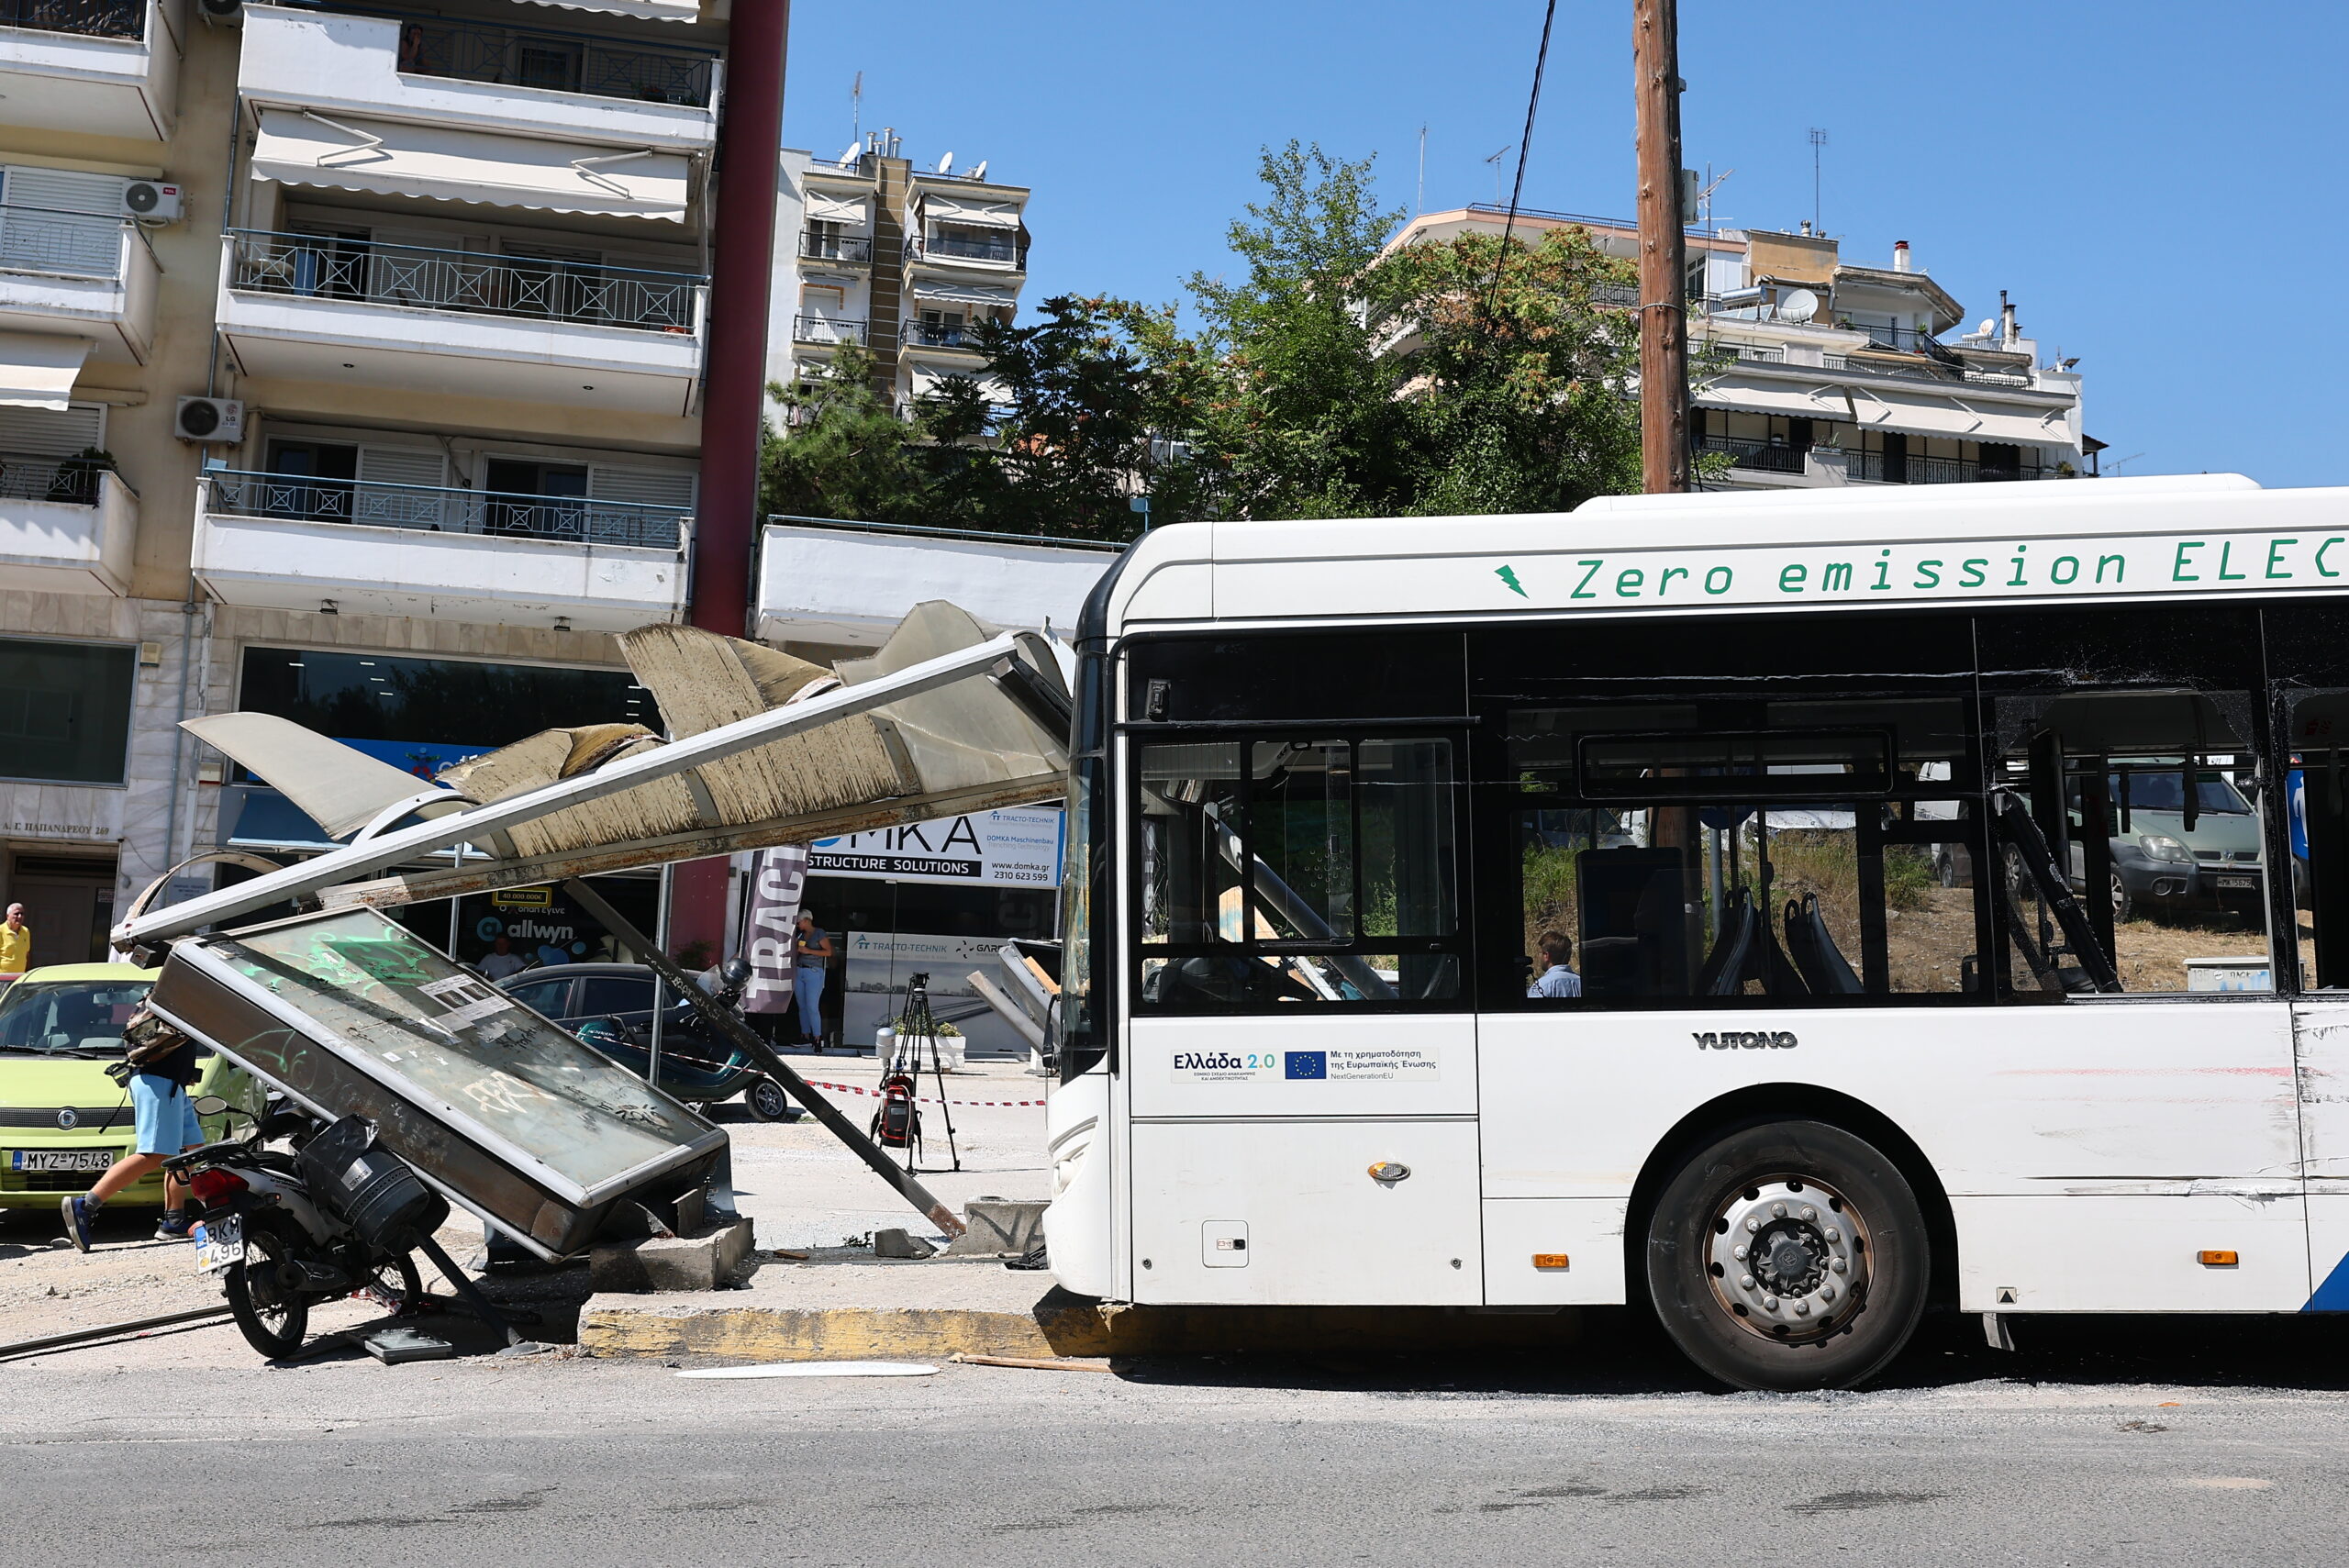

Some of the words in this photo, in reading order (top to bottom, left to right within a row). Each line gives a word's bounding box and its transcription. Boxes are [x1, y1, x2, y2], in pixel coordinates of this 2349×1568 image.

[1570, 560, 1733, 599] Zero
[1779, 545, 2125, 593] emission
[2172, 537, 2345, 582] ELEC
[1003, 815, 1054, 823] TRACTO-TECHNIK
[25, 822, 93, 835] ΠΑΠΑΝΔΡΕΟΥ
[95, 826, 110, 836] 269
[1011, 836, 1054, 845] Maschinenbau
[894, 859, 970, 874] SOLUTIONS
[991, 862, 1051, 872] www.domka.gr
[994, 871, 1014, 880] 2310
[1015, 872, 1030, 881] 623
[1032, 873, 1049, 882] 599
[746, 846, 807, 999] TRACT
[507, 919, 573, 944] allwyn
[874, 942, 947, 953] TRACTO-TECHNIK
[1691, 1031, 1798, 1051] YUTONG
[1174, 1051, 1242, 1069] Ελλάδα
[1247, 1053, 1275, 1069] 2.0
[1344, 1051, 1353, 1060] τη
[1355, 1051, 1421, 1060] χρηματοδότηση
[1330, 1062, 1344, 1070] της
[1346, 1061, 1398, 1070] Ευρωπαϊκής
[1400, 1060, 1437, 1069] Ένωσης
[210, 1241, 241, 1263] 496
